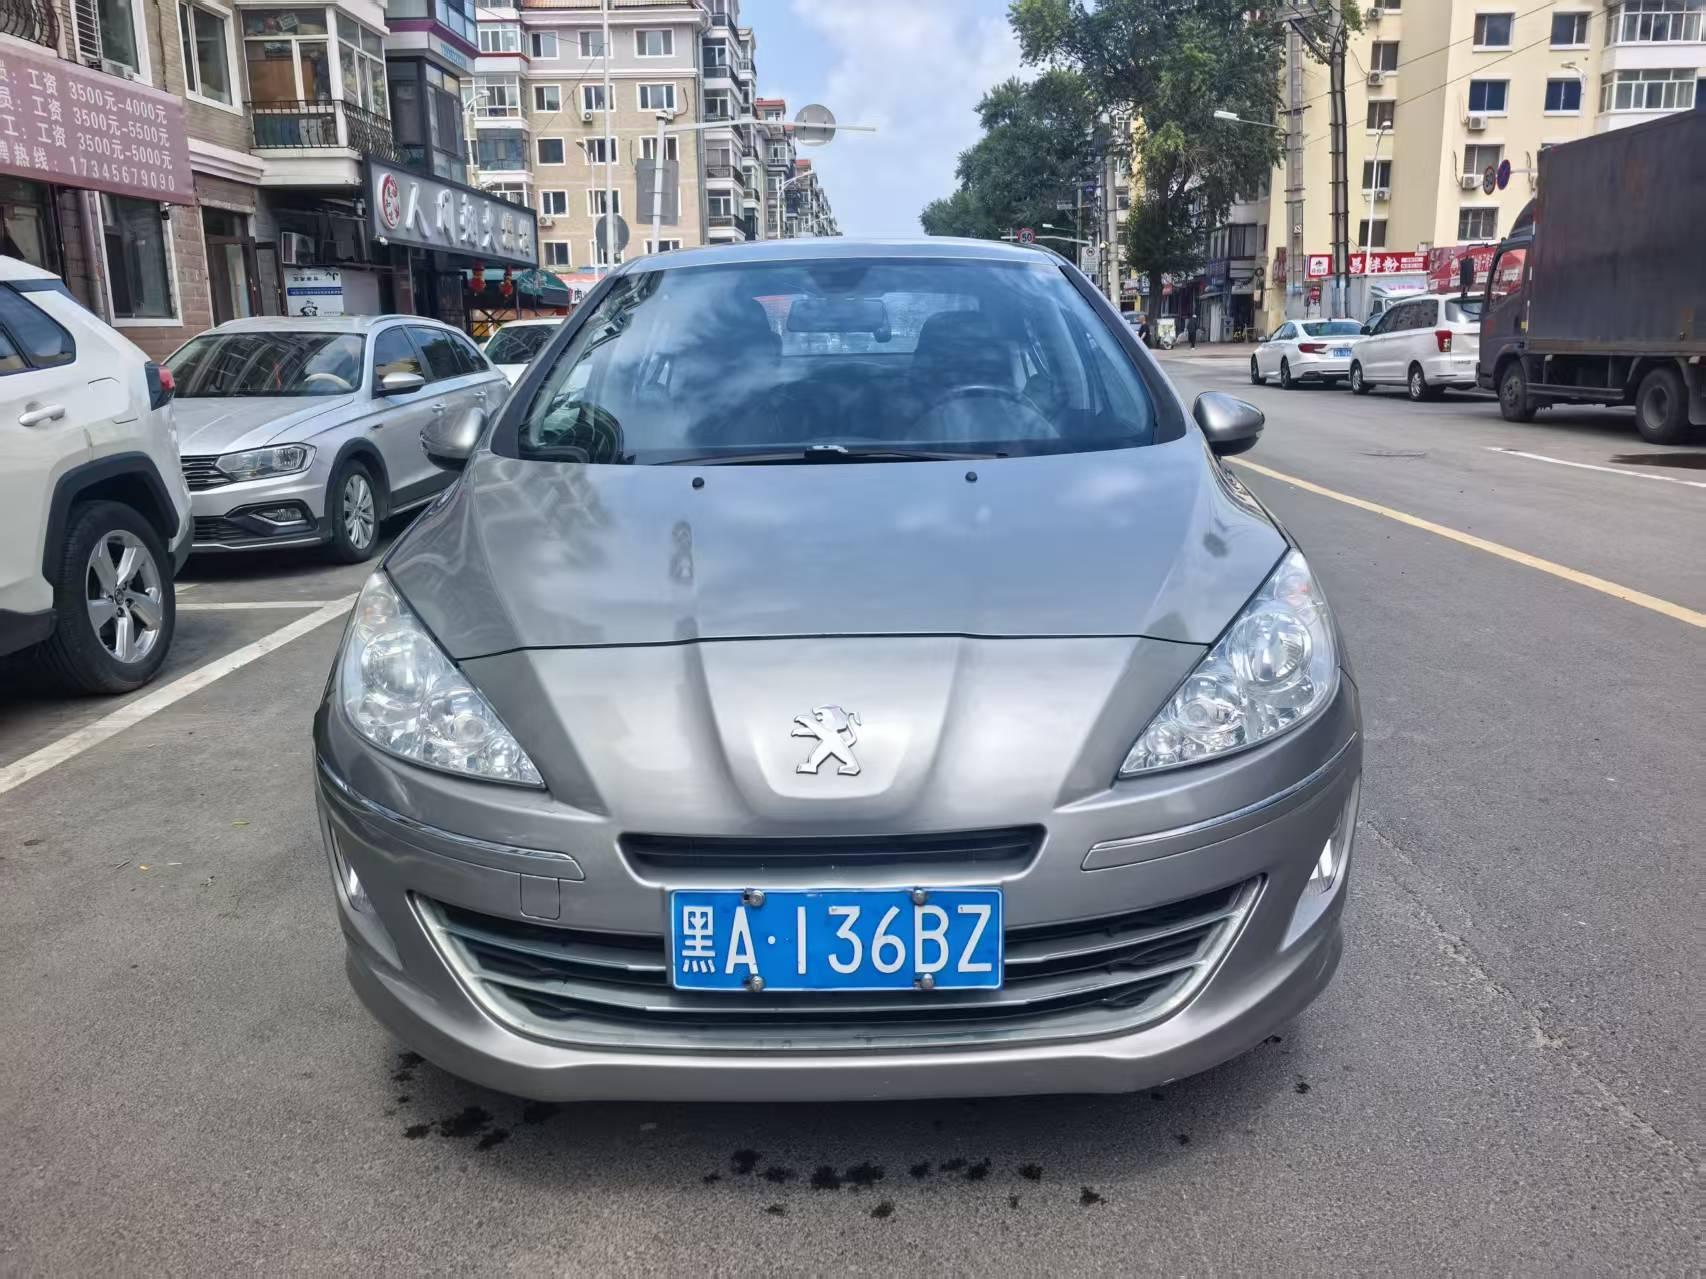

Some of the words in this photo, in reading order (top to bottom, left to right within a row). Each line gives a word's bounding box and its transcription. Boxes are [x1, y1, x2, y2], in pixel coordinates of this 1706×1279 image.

[27, 69, 57, 96] 工资
[69, 82, 167, 124] 3500元-4000元
[32, 96, 62, 122] 工资
[73, 107, 170, 147] 3500元-5500元
[37, 122, 67, 148] 工资
[77, 133, 172, 169] 3500元-5000元
[70, 156, 175, 191] 17345679090
[1021, 231, 1033, 242] 50
[681, 904, 993, 975] 黑A·136BZ
